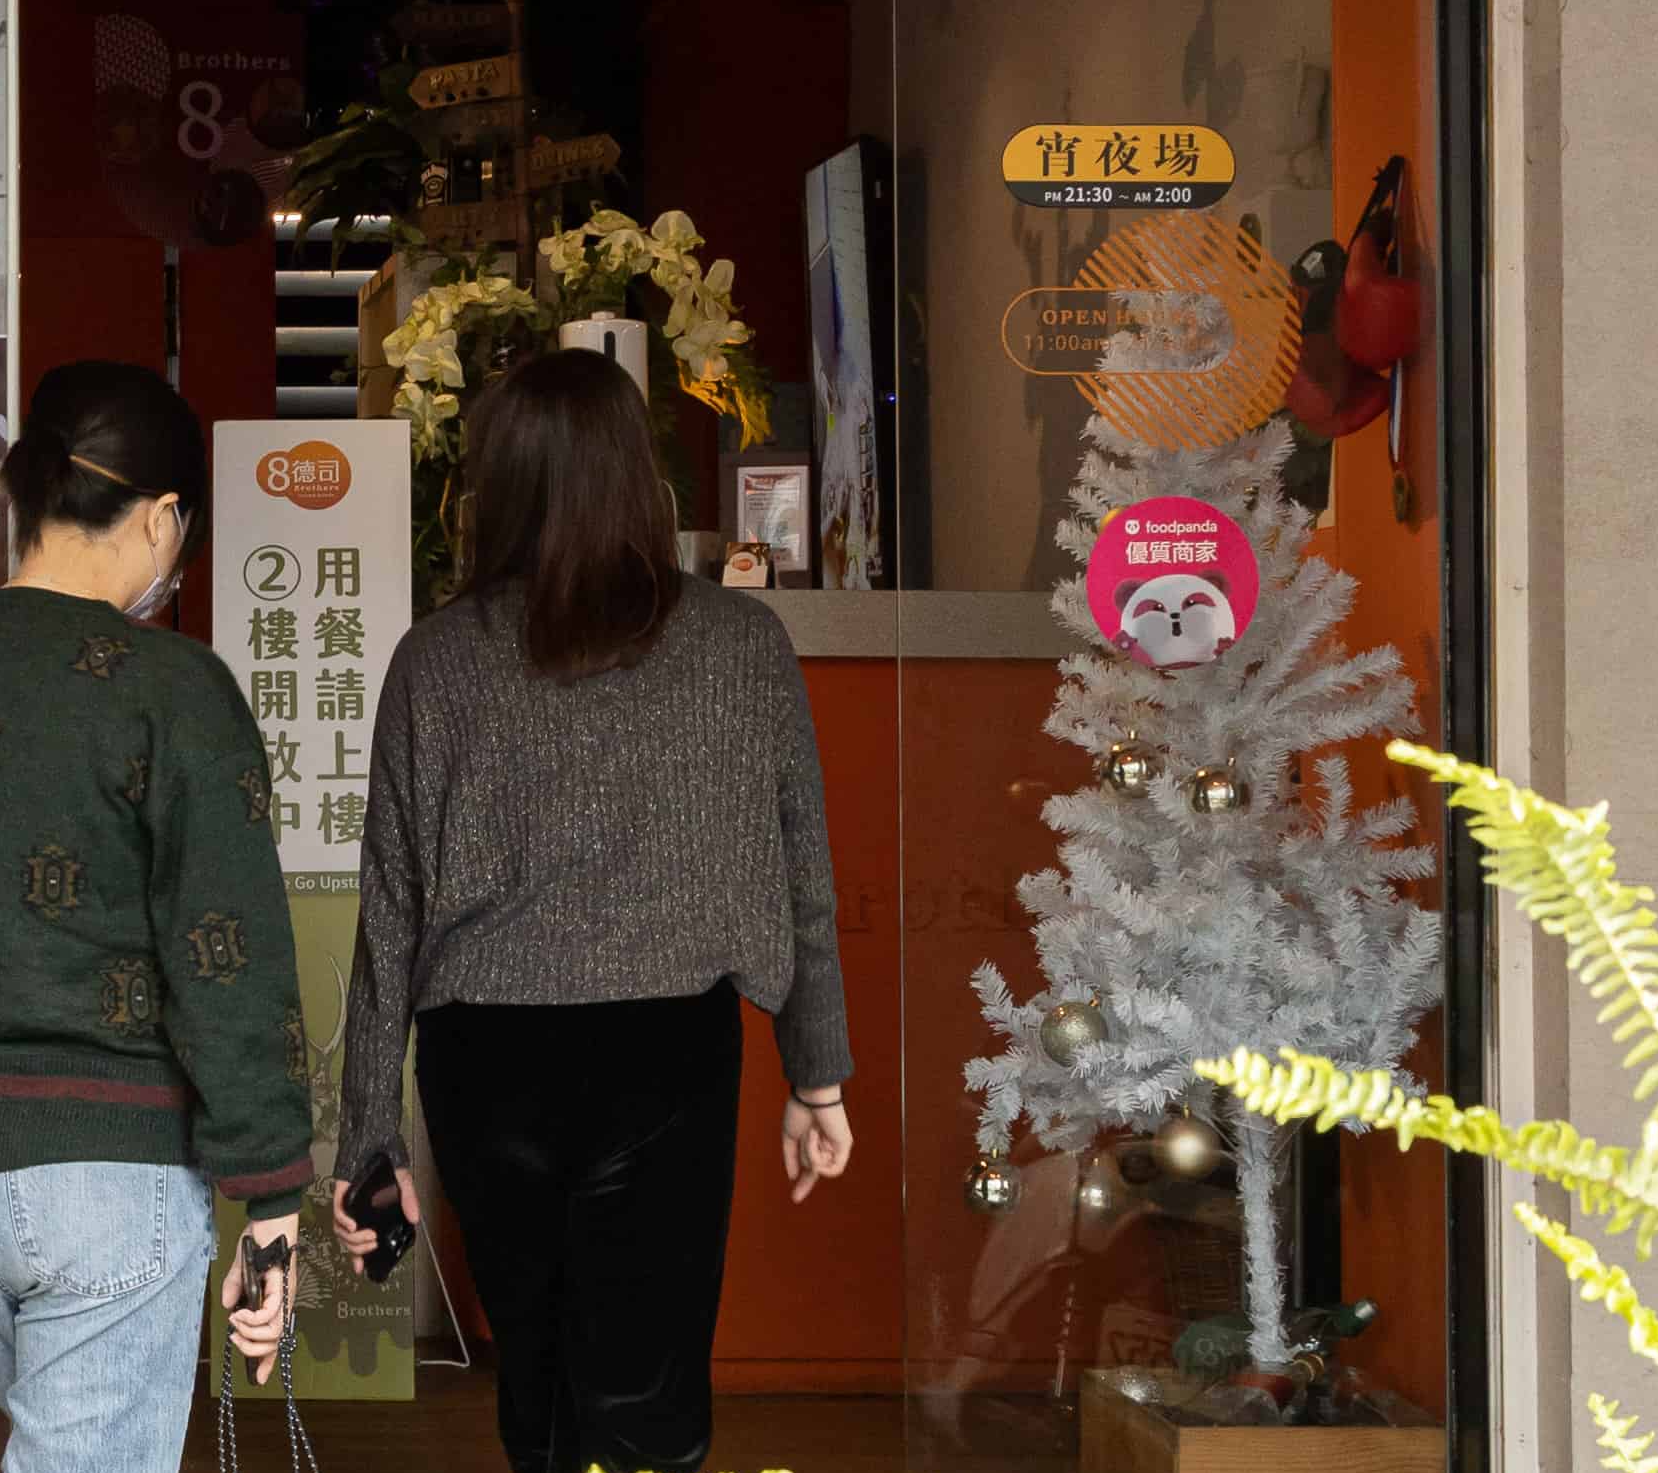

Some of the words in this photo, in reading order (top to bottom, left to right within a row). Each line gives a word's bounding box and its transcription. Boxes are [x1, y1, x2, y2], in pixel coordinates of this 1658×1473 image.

[1036, 131, 1200, 177] 宵夜場
[1044, 191, 1062, 203] PM
[1065, 187, 1113, 203] 21:30
[1134, 191, 1152, 203] AM
[1155, 187, 1192, 203] 2:00
[1043, 309, 1109, 325] OPEN
[1145, 519, 1218, 536] foodpanda
[1126, 539, 1219, 564] 優質商家
[313, 546, 369, 845] 用餐請上樓
[294, 875, 316, 891] Go
